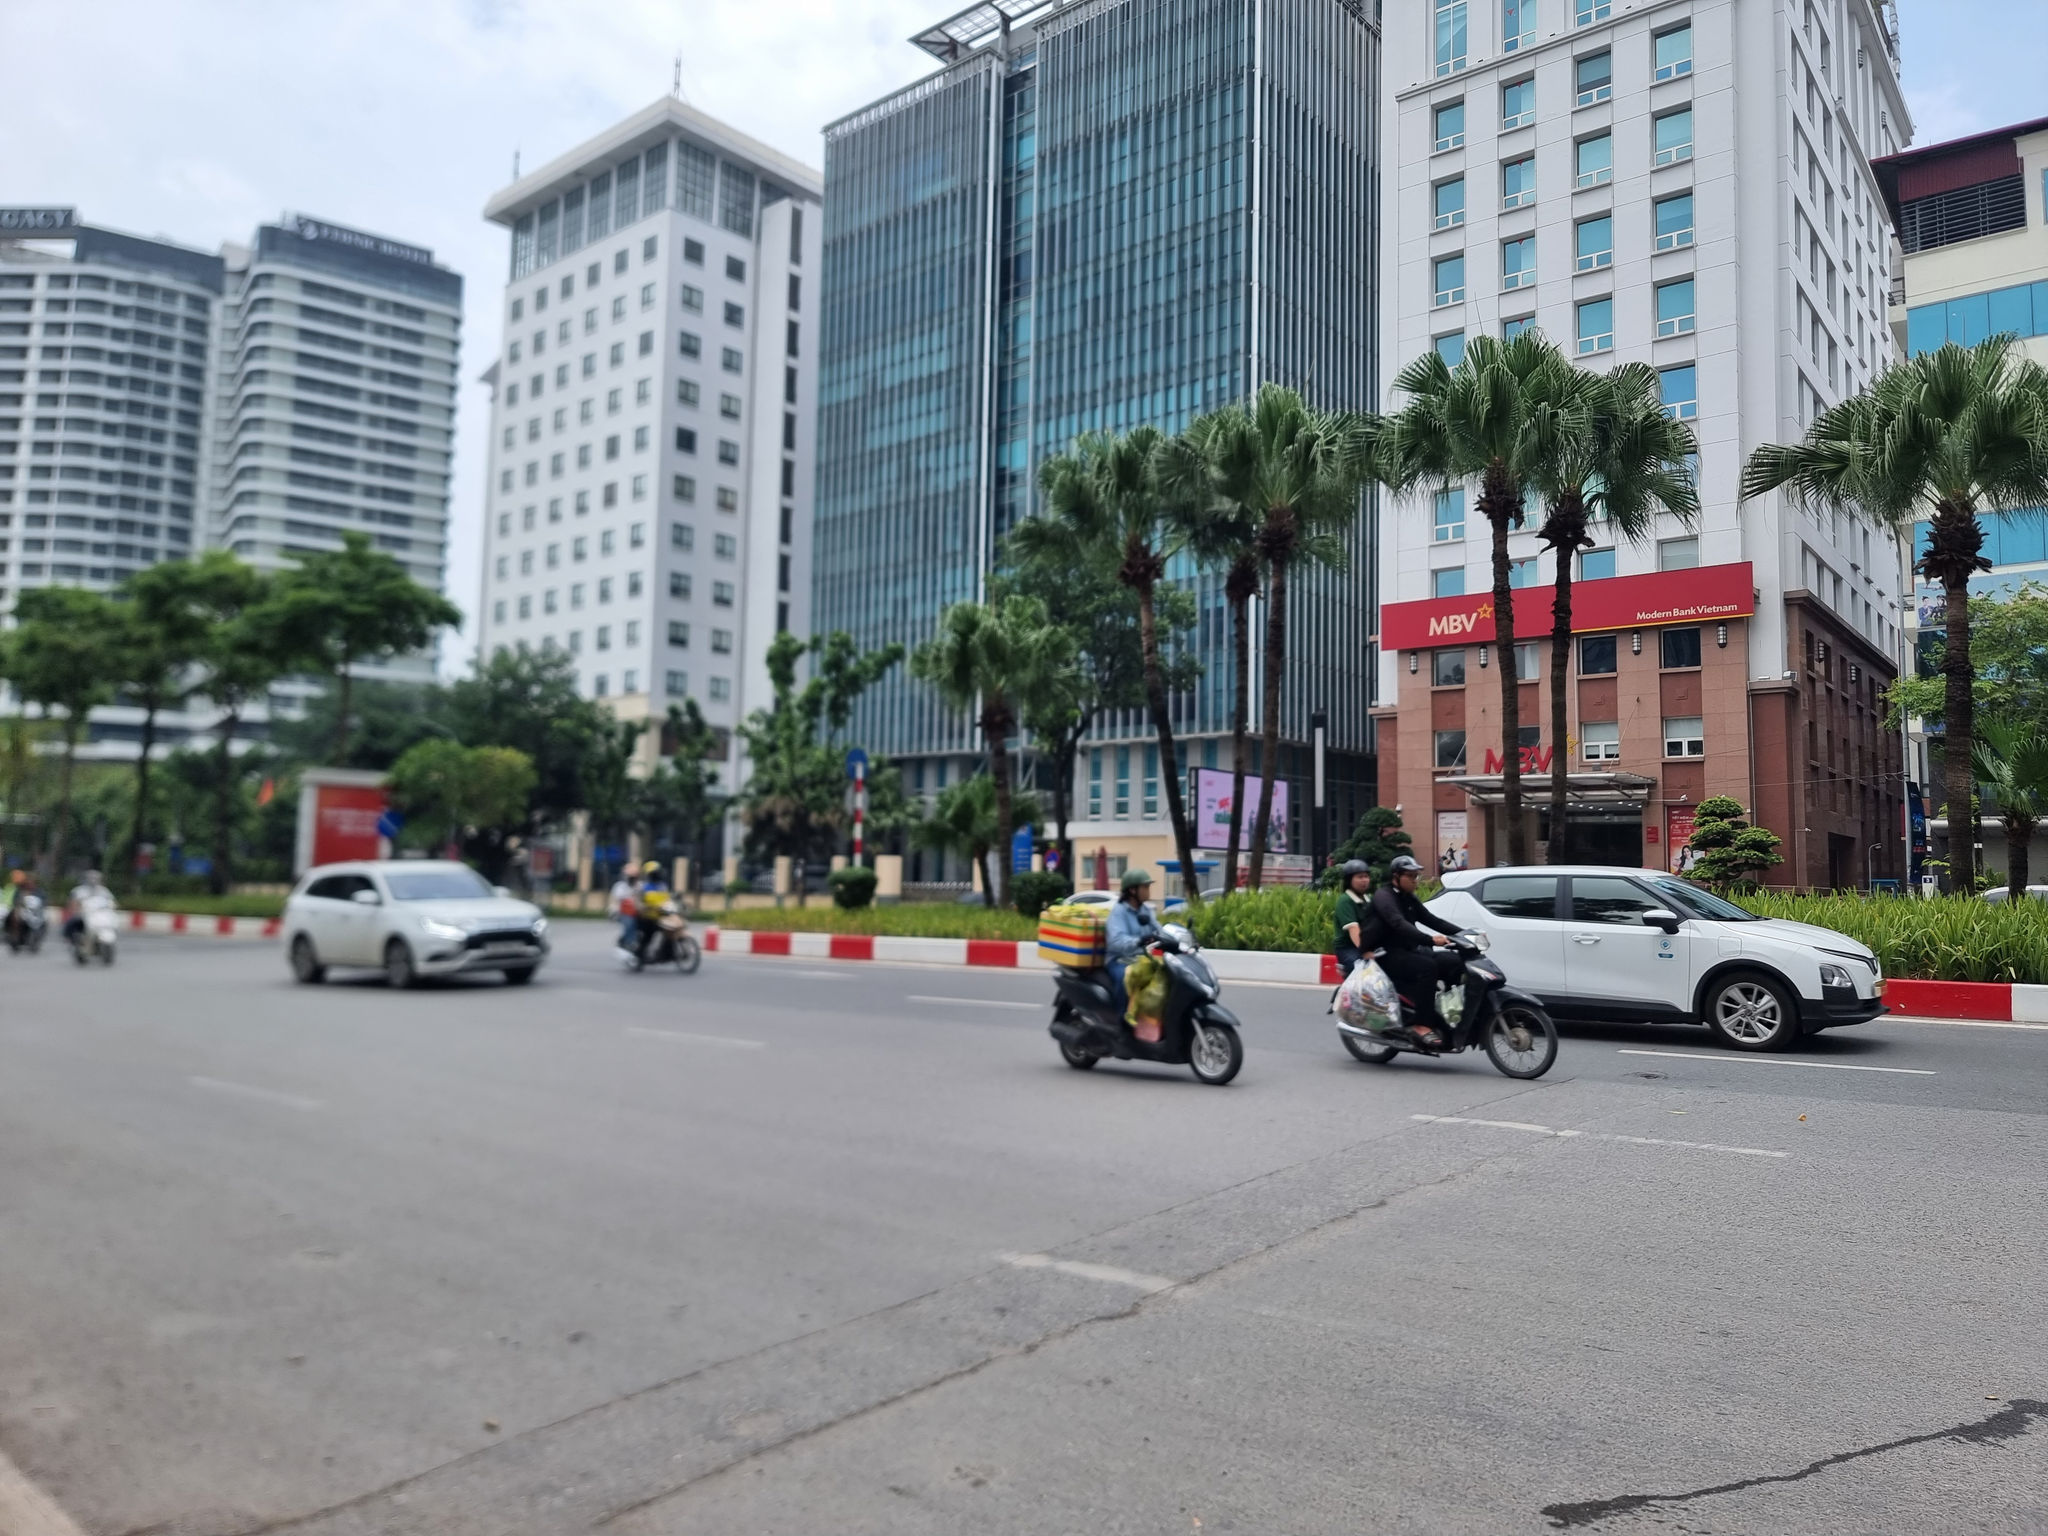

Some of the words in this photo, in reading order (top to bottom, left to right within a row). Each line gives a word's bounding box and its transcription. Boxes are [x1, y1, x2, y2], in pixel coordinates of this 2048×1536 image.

[1636, 610, 1672, 620] Modern
[1673, 606, 1696, 617] Bank
[1696, 604, 1738, 614] Vietnam
[1429, 612, 1478, 637] MBV
